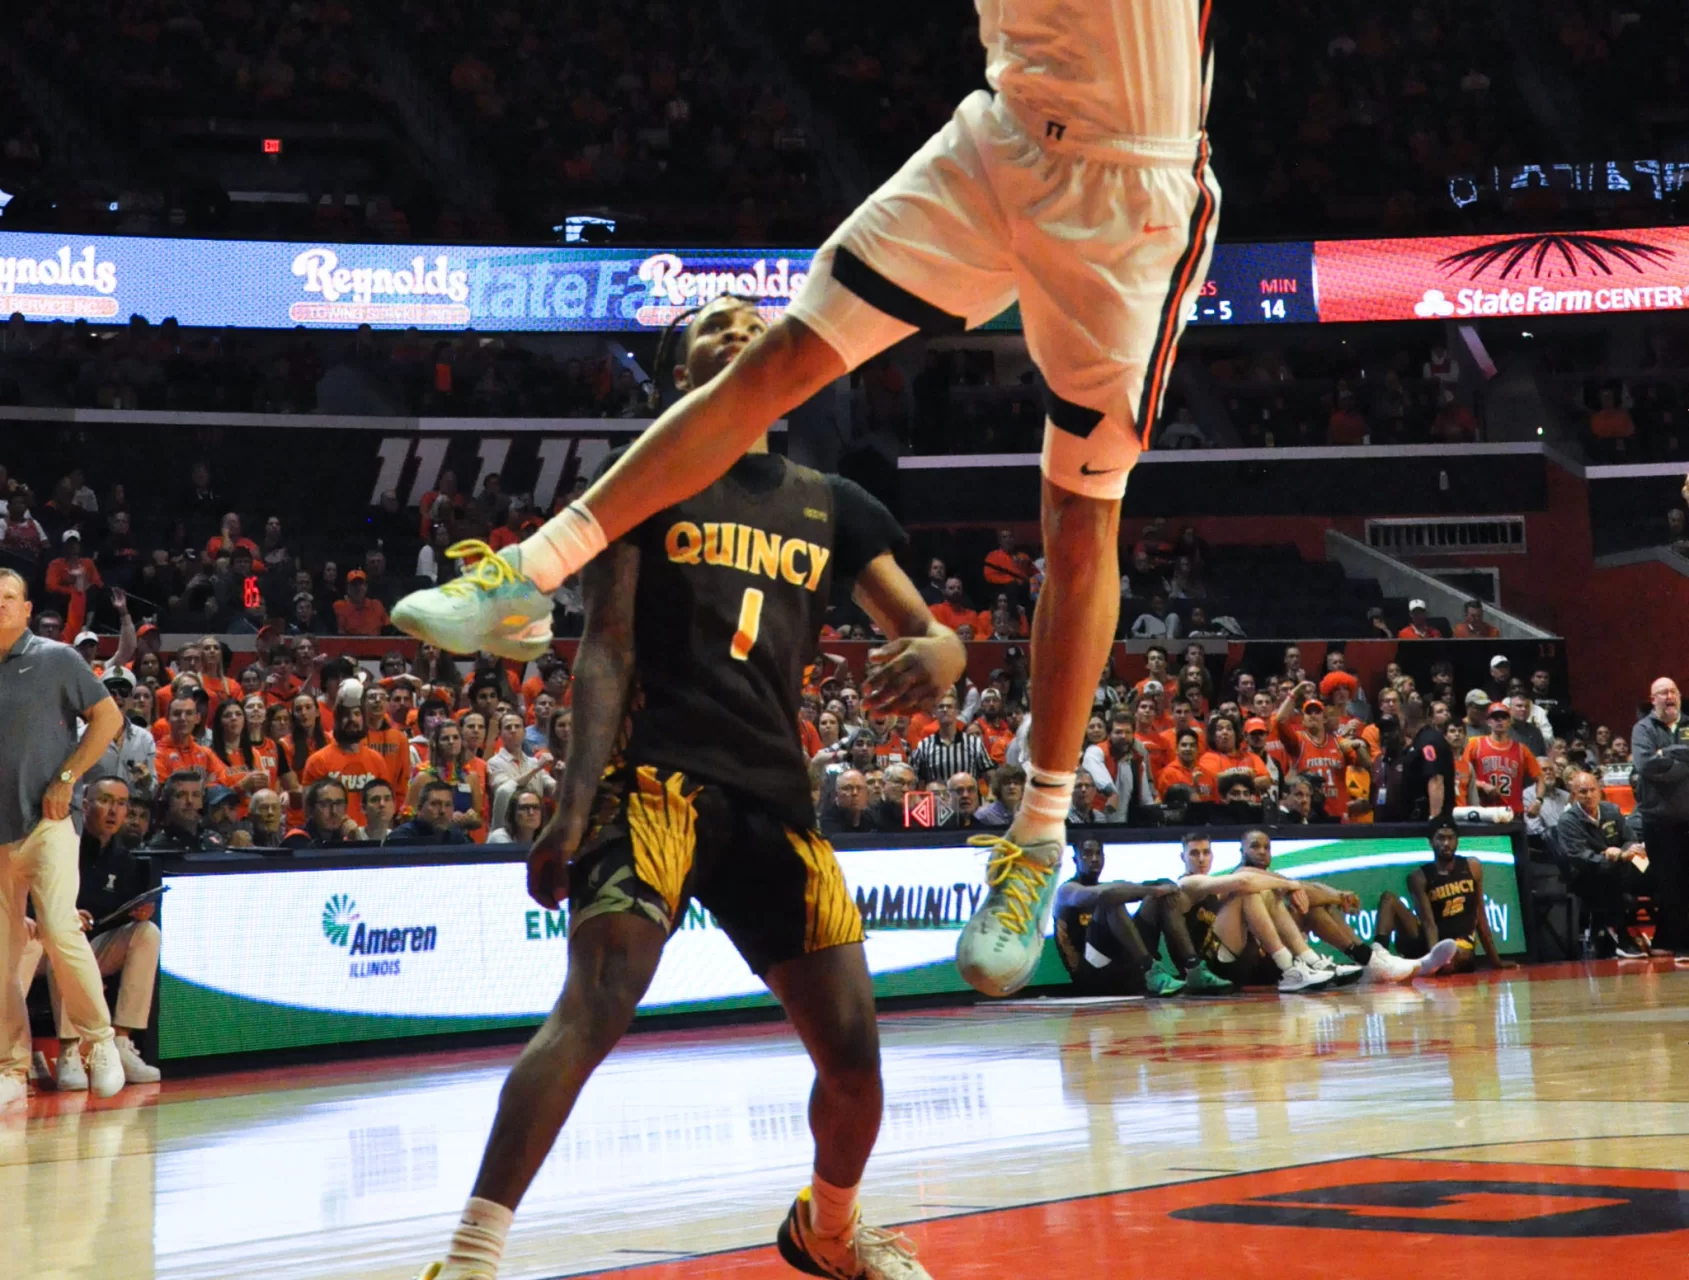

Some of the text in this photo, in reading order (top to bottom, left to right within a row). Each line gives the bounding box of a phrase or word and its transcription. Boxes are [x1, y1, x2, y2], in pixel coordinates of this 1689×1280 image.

[0, 245, 117, 294] ynolds
[291, 248, 469, 303] Reynolds
[1259, 278, 1297, 294] MIN
[1594, 285, 1683, 310] CENTER
[1260, 298, 1286, 319] 14
[665, 521, 830, 592] QUINCY
[730, 587, 764, 661] 1
[1490, 782, 1513, 807] 12
[1430, 878, 1475, 902] QUINCY
[856, 883, 982, 928] MMUNITY
[349, 922, 437, 956] Ameren
[349, 959, 401, 978] ILLINOIS
